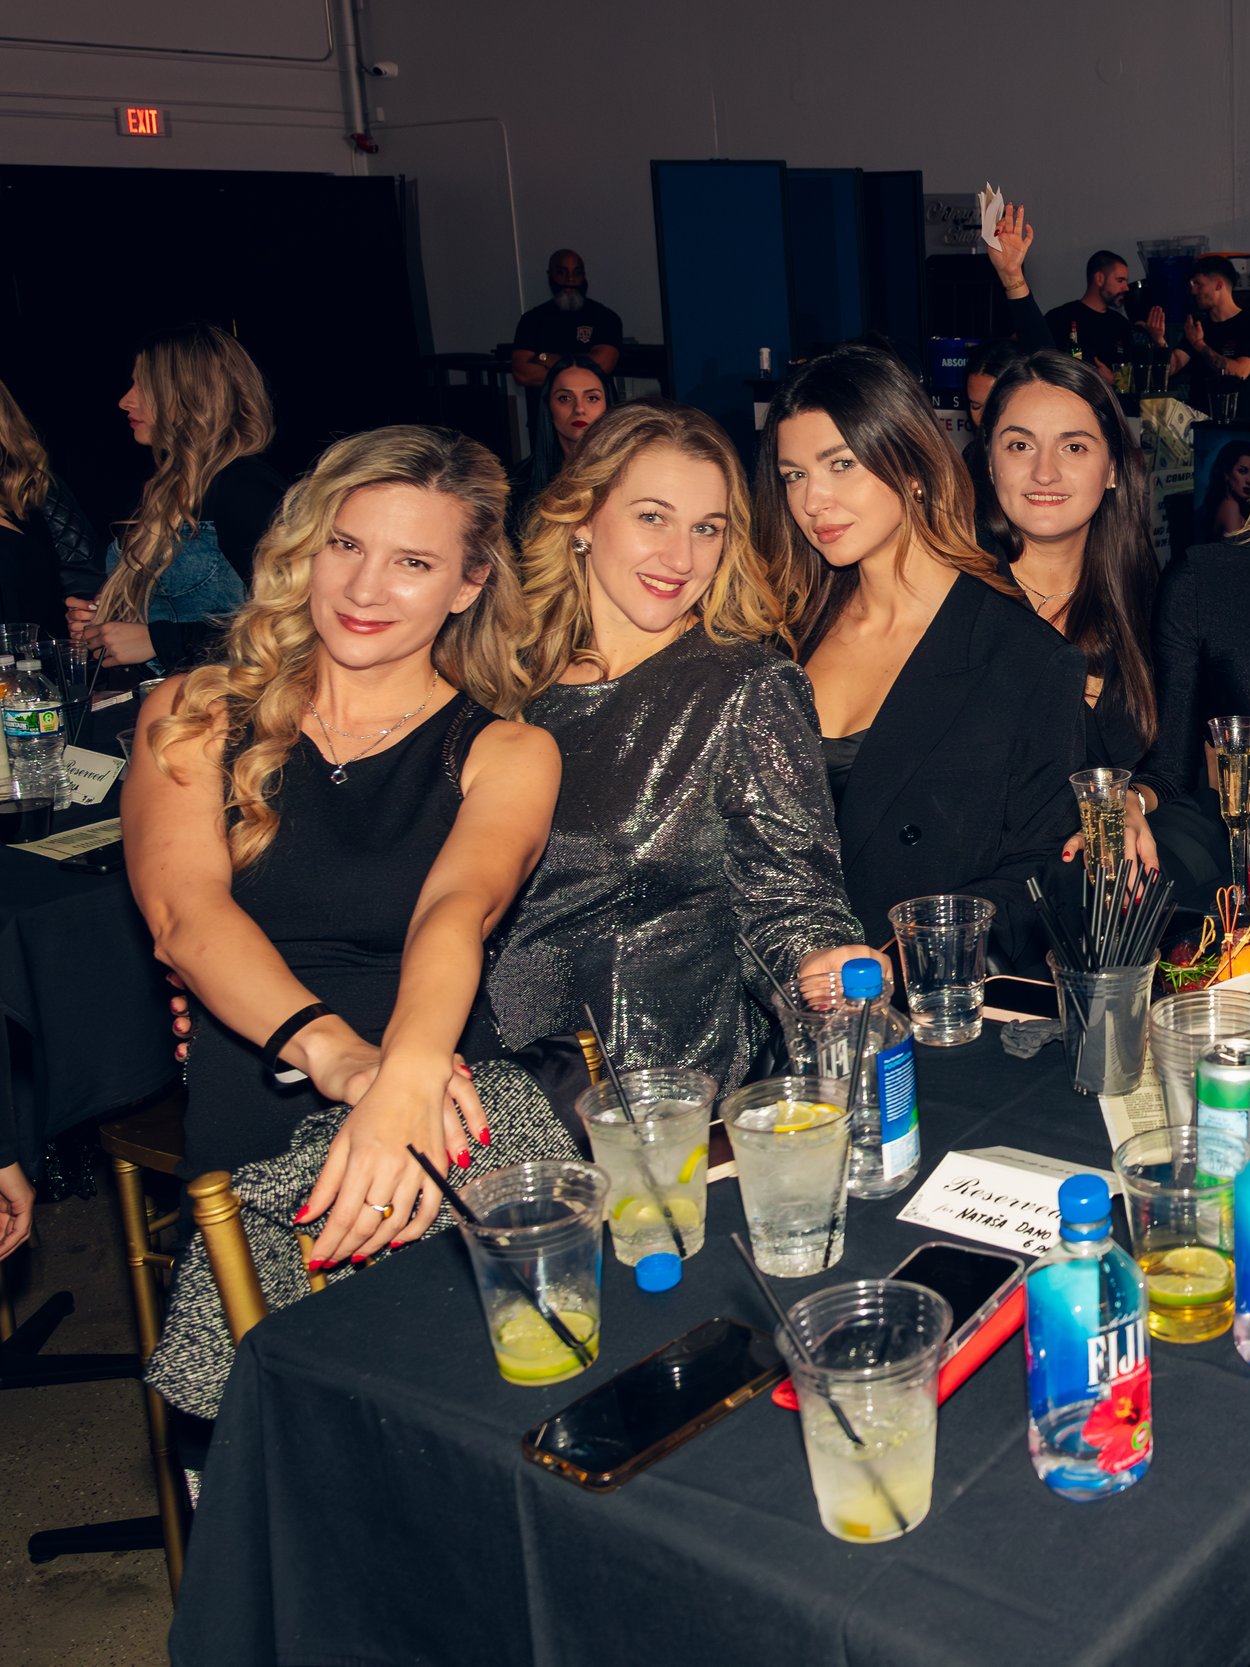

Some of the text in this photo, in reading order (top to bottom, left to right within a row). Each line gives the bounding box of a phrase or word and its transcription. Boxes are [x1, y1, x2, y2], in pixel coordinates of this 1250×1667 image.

[127, 108, 159, 135] EXIT
[66, 760, 111, 783] Reserved
[955, 1207, 1008, 1229] NATAŠA
[1015, 1221, 1052, 1240] DANO
[1023, 1239, 1034, 1248] 6
[1087, 1318, 1146, 1386] FIJI
